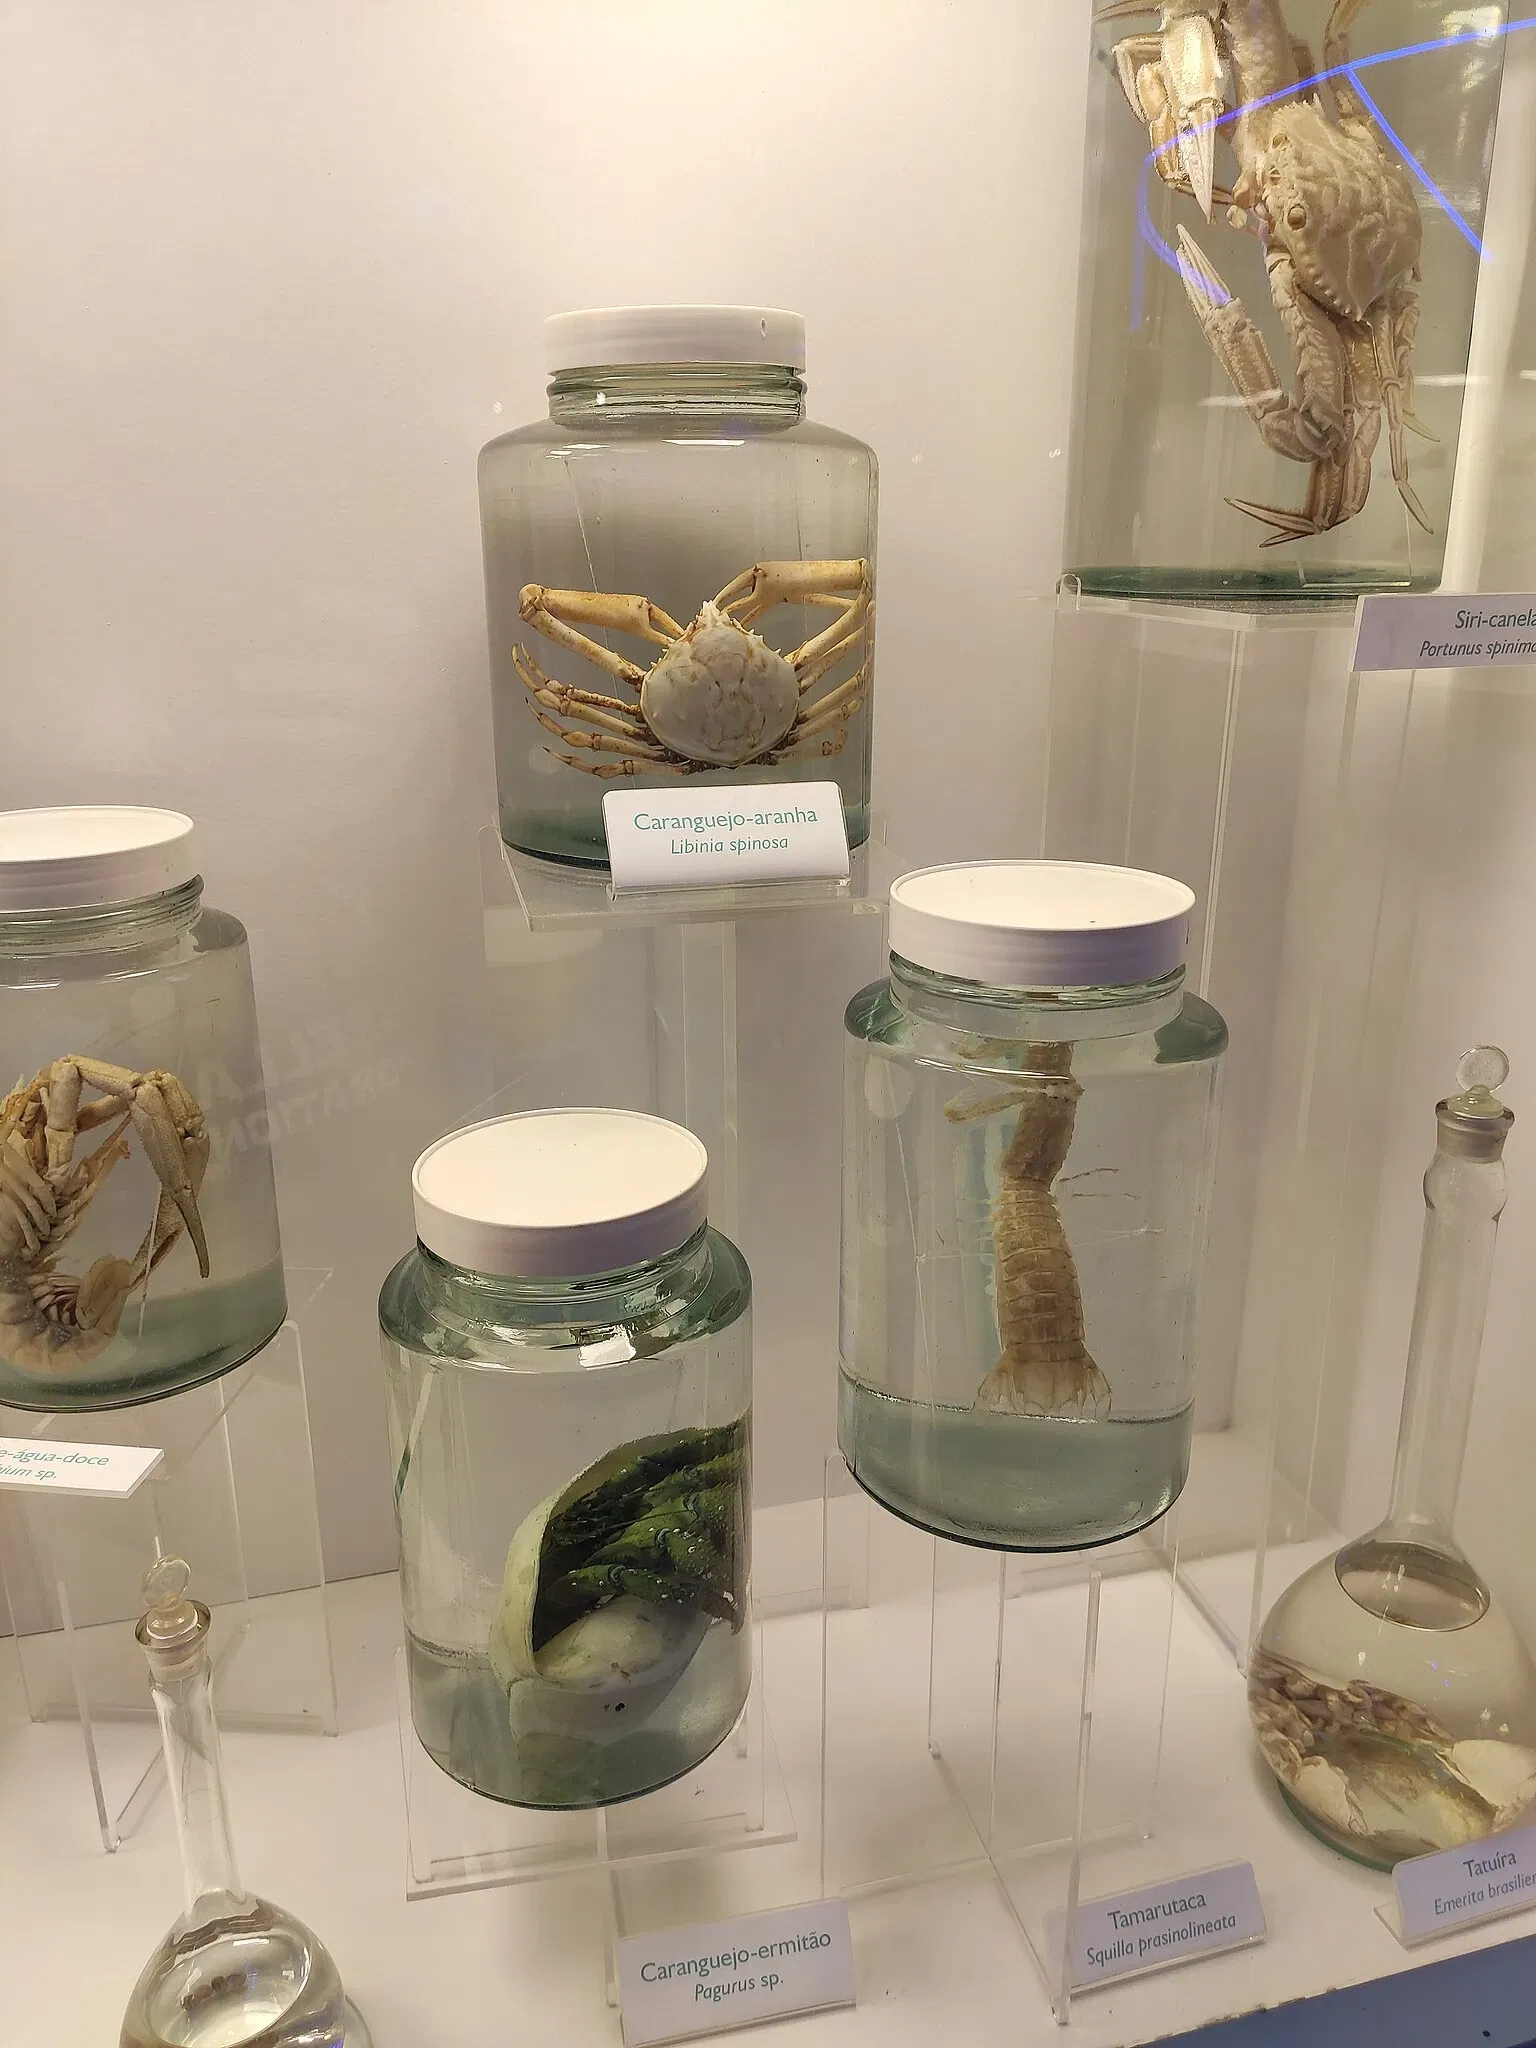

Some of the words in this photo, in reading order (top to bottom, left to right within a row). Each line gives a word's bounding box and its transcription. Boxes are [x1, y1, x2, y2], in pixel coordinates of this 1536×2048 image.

[1419, 640, 1483, 657] Portunus
[633, 806, 818, 833] Caranguejo-aranha
[671, 838, 724, 855] Libinia
[729, 836, 788, 855] spinosa
[34, 1469, 57, 1481] sp.
[1462, 1852, 1517, 1878] Tatuíra
[1107, 1893, 1207, 1930] Tamarutaca
[1434, 1890, 1484, 1915] Emerita
[1086, 1939, 1134, 1966] Squilla
[1138, 1914, 1236, 1957] prasinolineata
[640, 1931, 832, 1983] Caranguejo-ermitão
[694, 1976, 756, 2002] Pagurus
[760, 1972, 784, 1992] sp.
